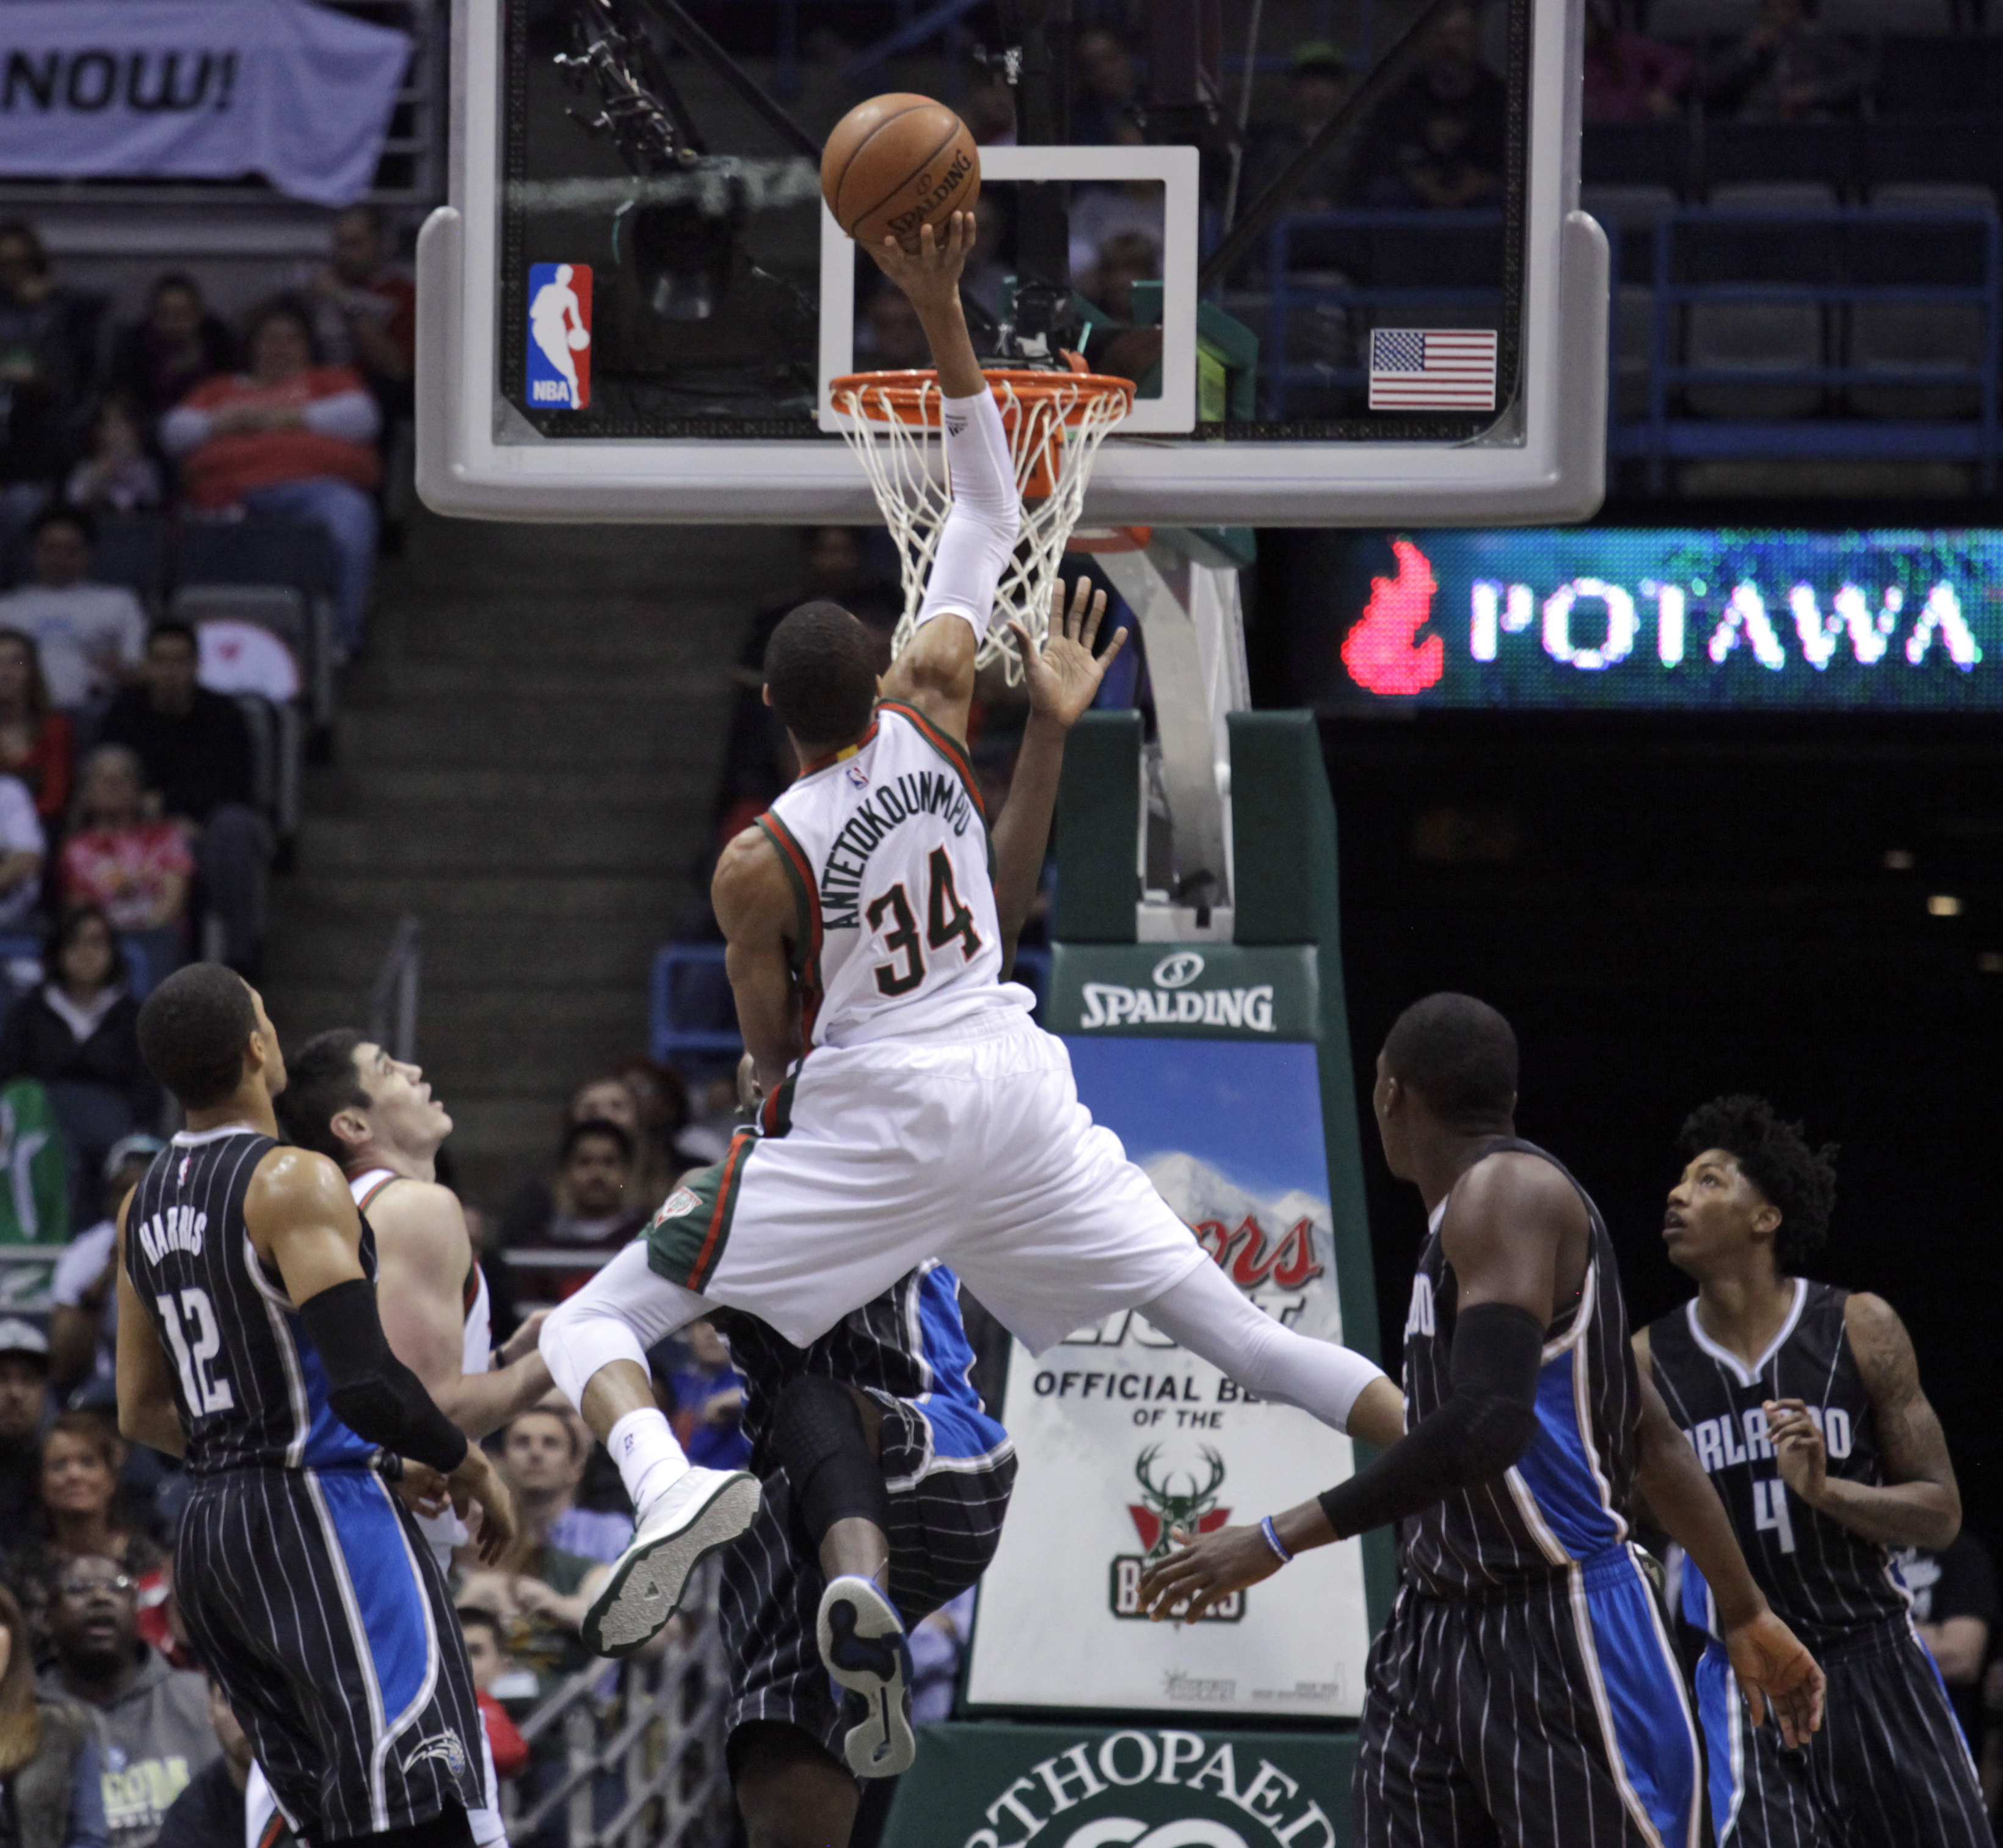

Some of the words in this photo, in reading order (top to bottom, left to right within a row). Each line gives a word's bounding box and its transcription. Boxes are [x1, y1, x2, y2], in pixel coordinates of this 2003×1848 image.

[1, 49, 239, 114] NOW!
[533, 380, 570, 402] NBA
[1469, 577, 1982, 671] POTAWA
[865, 843, 983, 998] 34
[1080, 982, 1274, 1032] SPALDING
[139, 1204, 208, 1267] HARRIS
[156, 1287, 234, 1417] 12
[1034, 1371, 1201, 1402] OFFICIAL
[1133, 1408, 1167, 1427] OF
[1177, 1410, 1225, 1430] THE
[1753, 1479, 1796, 1554] 4
